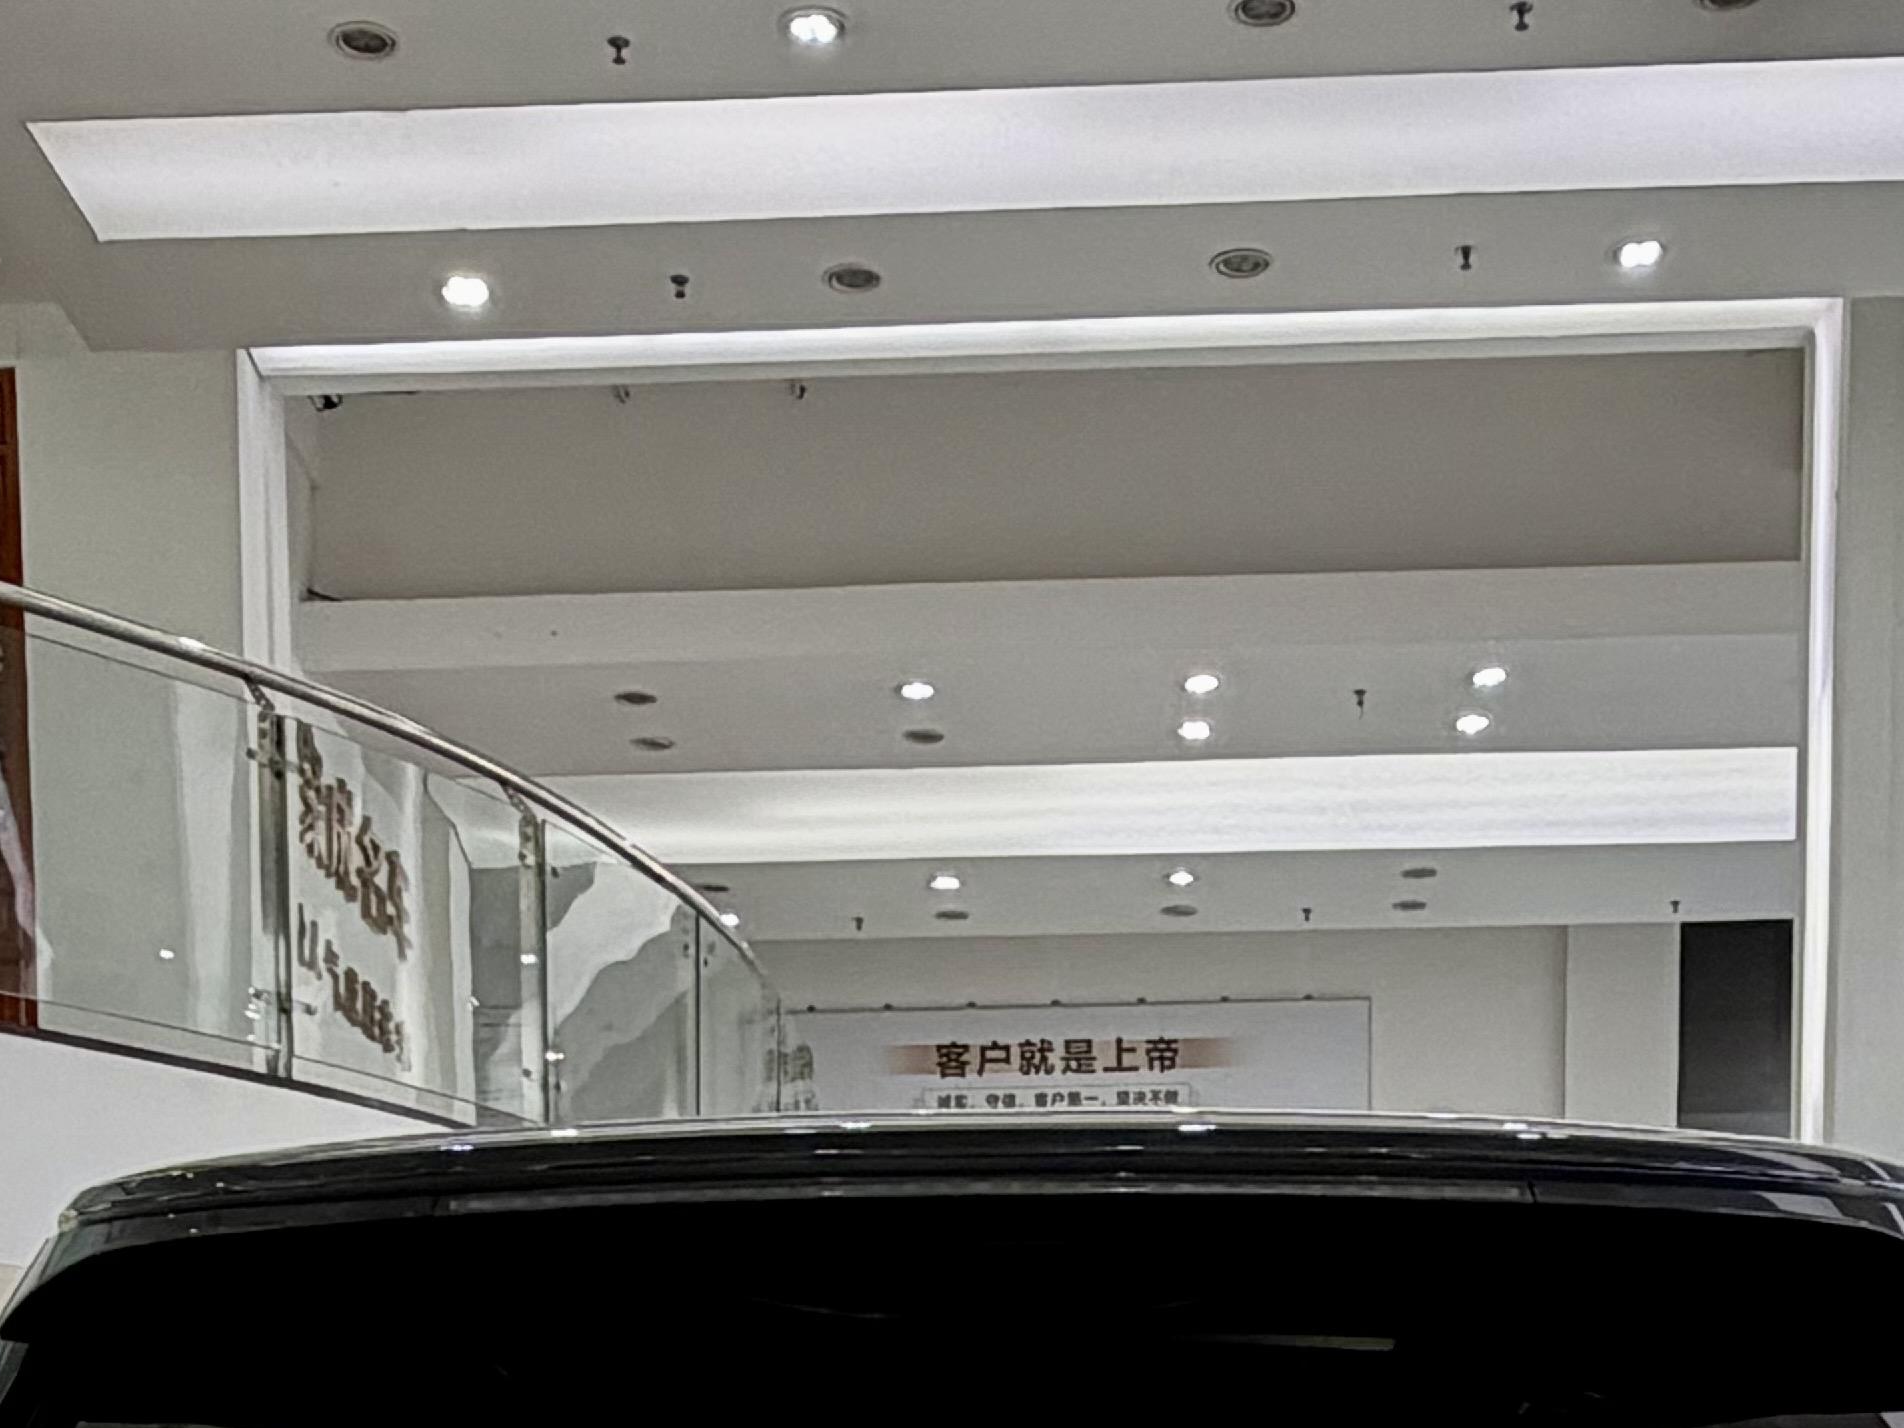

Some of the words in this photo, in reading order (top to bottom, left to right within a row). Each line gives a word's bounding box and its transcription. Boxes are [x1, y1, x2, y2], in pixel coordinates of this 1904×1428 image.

[935, 1037, 1179, 1078] 客户就是上帝
